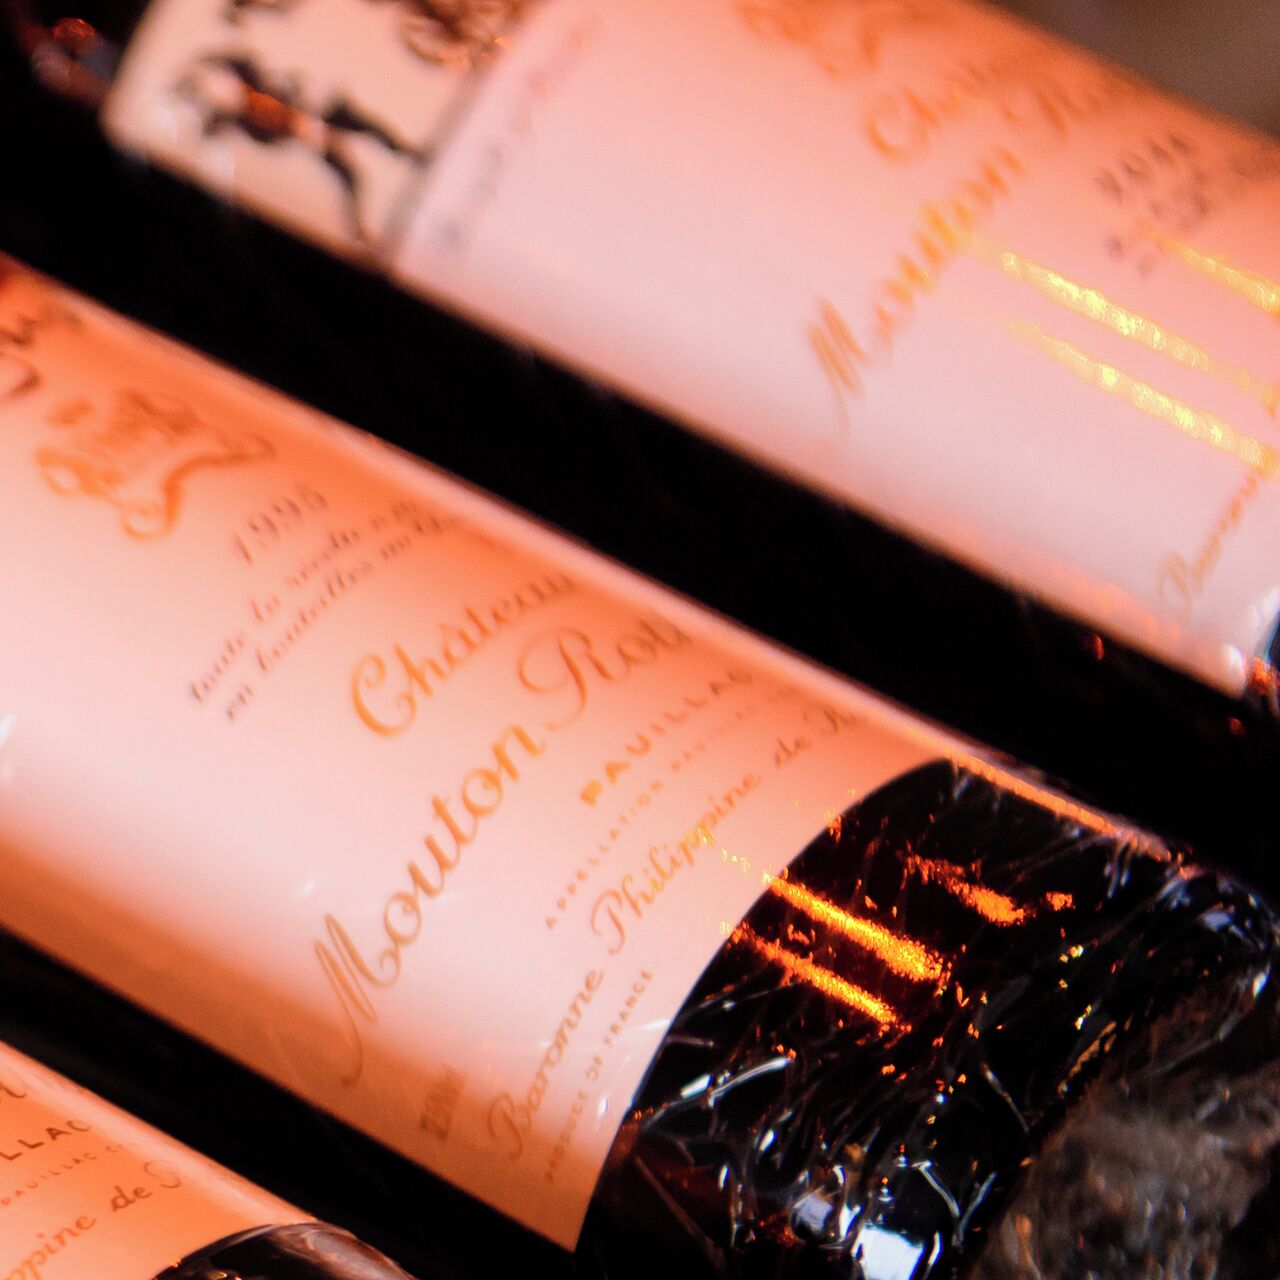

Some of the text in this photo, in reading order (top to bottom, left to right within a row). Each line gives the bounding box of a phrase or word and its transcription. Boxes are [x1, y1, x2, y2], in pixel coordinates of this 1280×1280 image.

[349, 566, 577, 740] Château
[314, 722, 547, 1088] Mouton
[490, 969, 604, 1162] Baronne
[591, 774, 762, 956] Philippine
[587, 1055, 603, 1082] OF
[604, 969, 652, 1047] FRANCE
[0, 1151, 97, 1207] PAUILLAC
[110, 1184, 154, 1215] de
